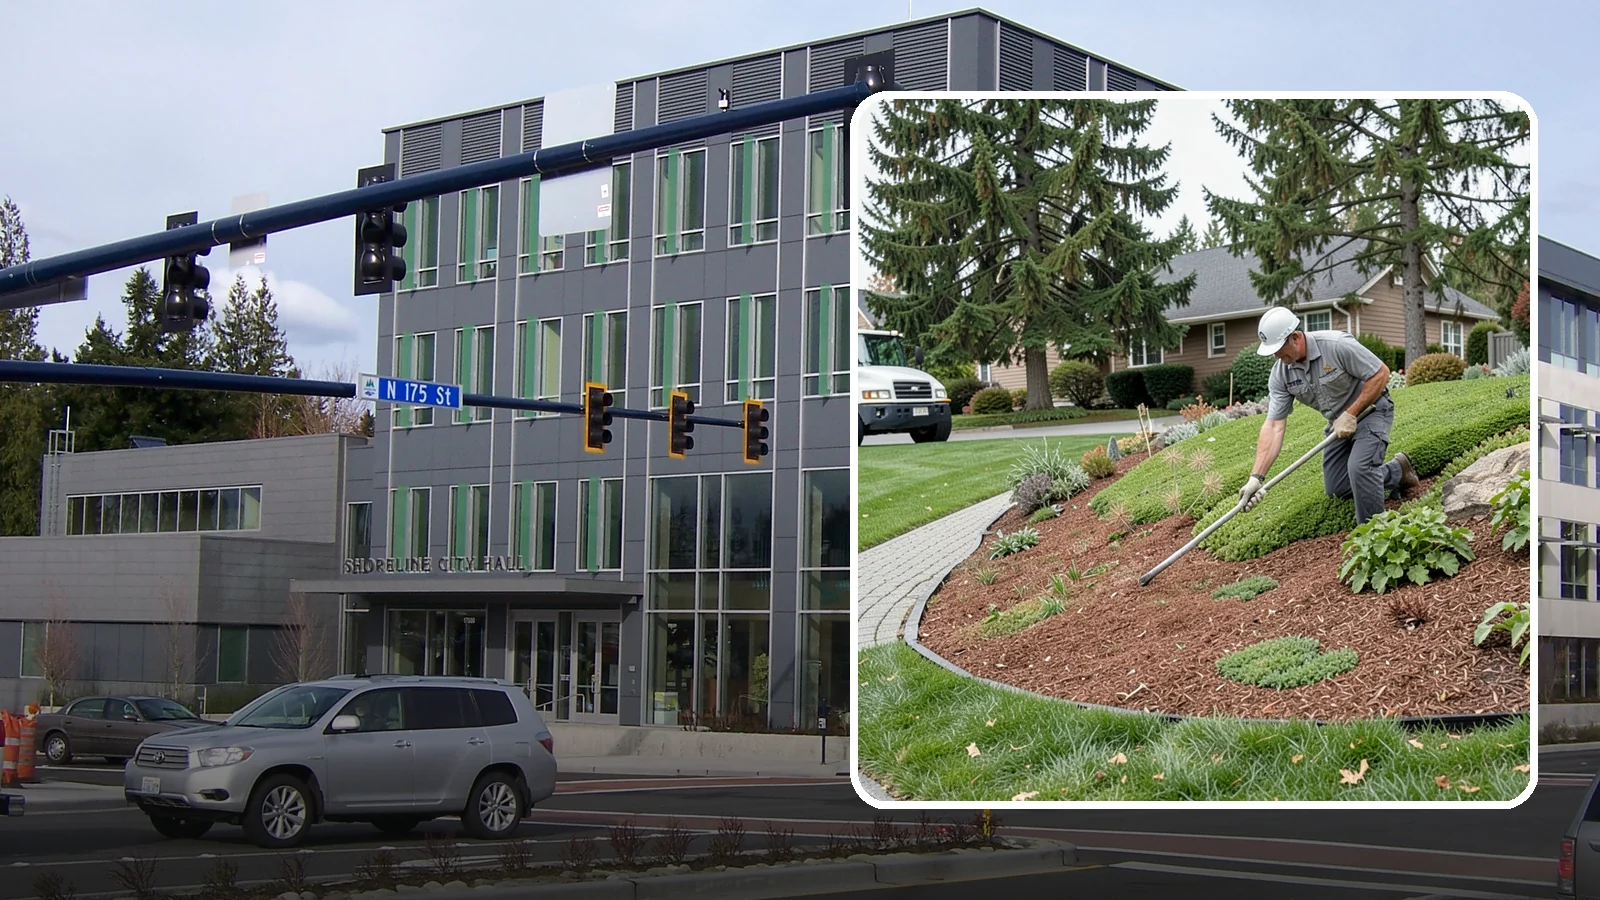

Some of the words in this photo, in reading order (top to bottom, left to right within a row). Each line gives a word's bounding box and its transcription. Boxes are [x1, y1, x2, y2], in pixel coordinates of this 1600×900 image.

[387, 380, 396, 400] N
[405, 382, 428, 403] 175
[436, 386, 451, 406] St
[343, 557, 432, 574] SHORELINE
[438, 557, 476, 572] CITY
[484, 556, 525, 571] HALL
